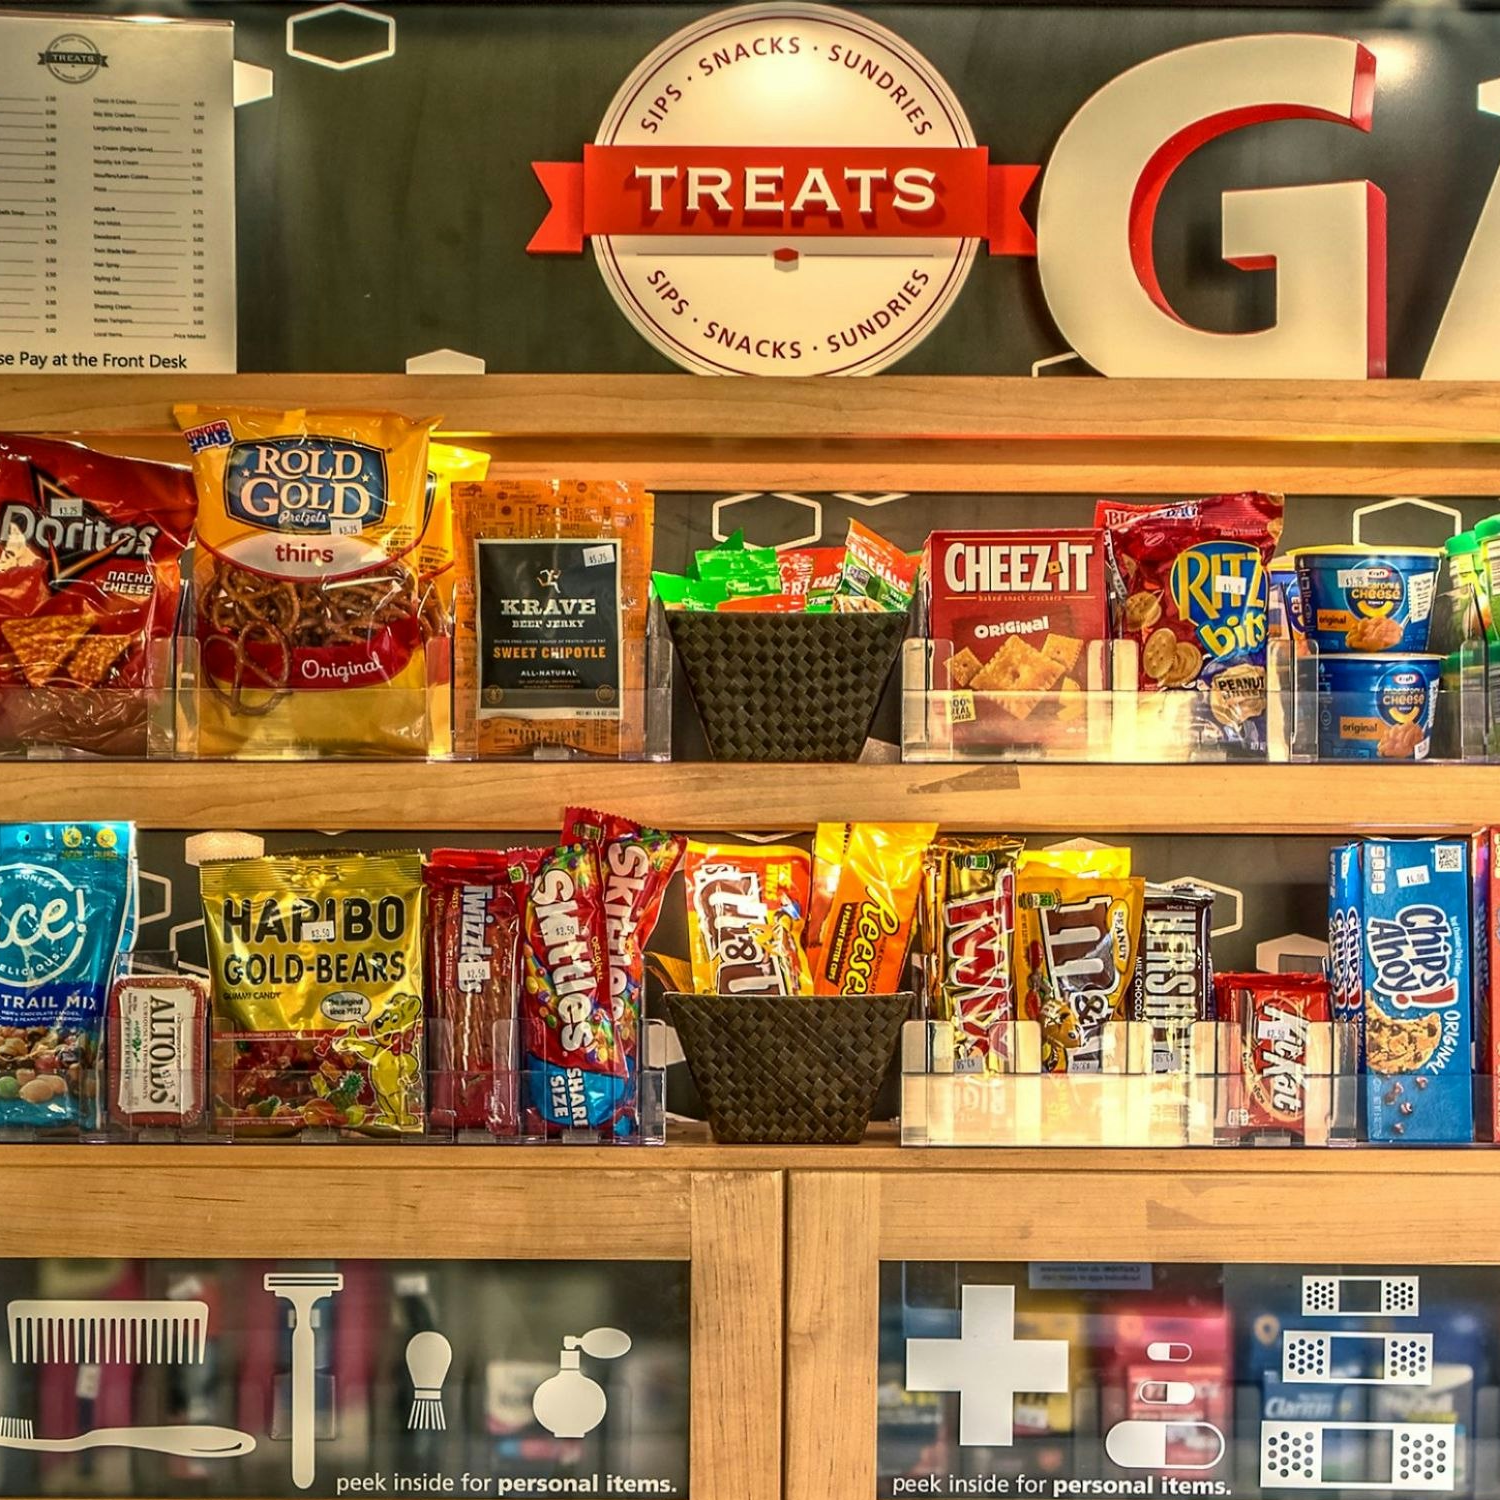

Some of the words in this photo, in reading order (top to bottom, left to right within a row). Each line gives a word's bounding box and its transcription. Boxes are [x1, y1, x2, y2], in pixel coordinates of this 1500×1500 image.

[51, 53, 96, 65] TREATS
[641, 83, 683, 134] SIPS
[698, 36, 801, 77] SNACKS
[828, 43, 934, 137] SUNDRIES
[634, 164, 937, 214] TREATS
[647, 268, 687, 317] SIPS
[703, 320, 802, 360] SNACKS
[827, 268, 930, 354] SUNDRIES
[19, 352, 48, 370] Pay
[53, 353, 69, 368] at
[72, 352, 98, 368] the
[102, 352, 145, 368] Front
[149, 353, 188, 370] Desk
[255, 445, 363, 480] ROLD
[240, 477, 371, 519] GOLD
[0, 504, 159, 556] Doritos
[278, 510, 328, 526] Pretzels
[275, 543, 334, 563] thins
[102, 582, 153, 595] CHEESE
[107, 570, 153, 584] NACHO
[1176, 551, 1265, 622] RITZ
[500, 598, 596, 616] KRAVE
[511, 619, 543, 629] BEEF
[545, 619, 586, 629] JERKY
[1200, 610, 1267, 657] bits
[301, 651, 382, 682] Original
[492, 646, 537, 659] SWEET
[541, 646, 607, 659] CHIPOTLE
[1217, 676, 1265, 691] PEANUT
[1342, 723, 1378, 732] original
[14, 872, 57, 891] HONEST
[222, 895, 406, 944] HARIBO
[1112, 910, 1127, 961] PEANUT
[1397, 905, 1453, 991] Chips
[222, 951, 407, 986] GOLD-BEARS
[1134, 956, 1143, 980] MILK
[252, 990, 281, 1000] CANDY
[1425, 1010, 1461, 1076] ORIGINAL
[549, 1075, 570, 1119] SIZE
[566, 1067, 589, 1128] SHARE
[336, 1472, 387, 1496] peek
[394, 1472, 454, 1492] inside
[460, 1471, 492, 1492] for
[497, 1473, 599, 1496] personal
[606, 1474, 677, 1493] items.
[892, 1474, 942, 1497] peek
[949, 1473, 1009, 1493] inside
[1015, 1474, 1047, 1493] for
[1052, 1475, 1153, 1498] personal
[1161, 1476, 1232, 1496] items.
